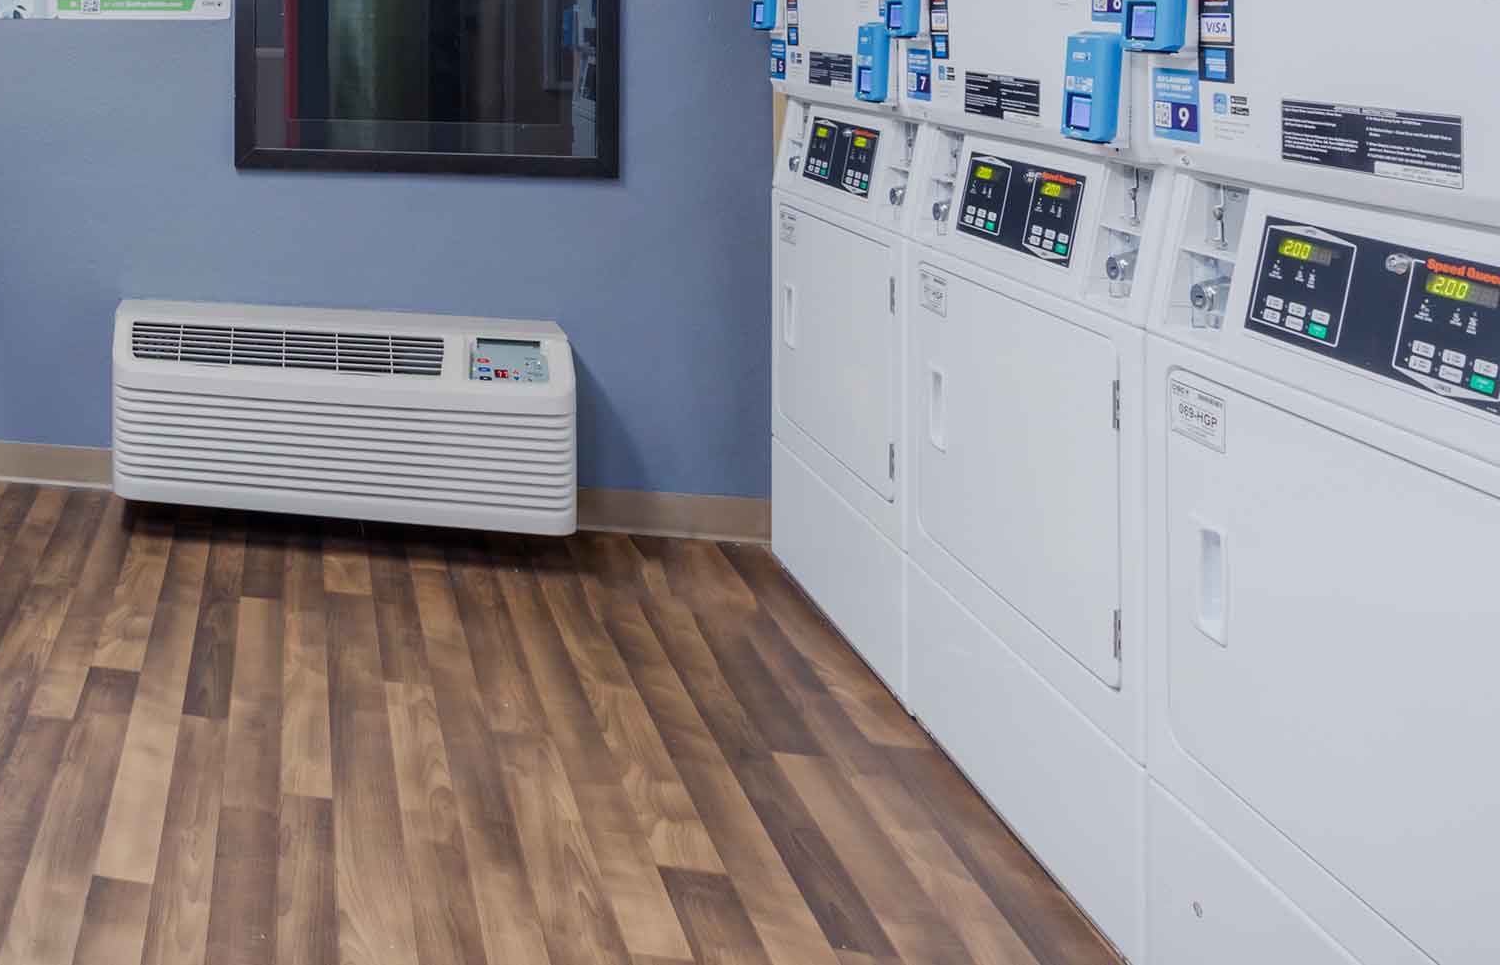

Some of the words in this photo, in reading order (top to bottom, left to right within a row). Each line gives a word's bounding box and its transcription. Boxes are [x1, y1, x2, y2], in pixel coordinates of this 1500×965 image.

[1205, 22, 1228, 34] VISA
[920, 75, 927, 90] 7
[1178, 107, 1190, 128] 9
[1427, 258, 1467, 278] Speed
